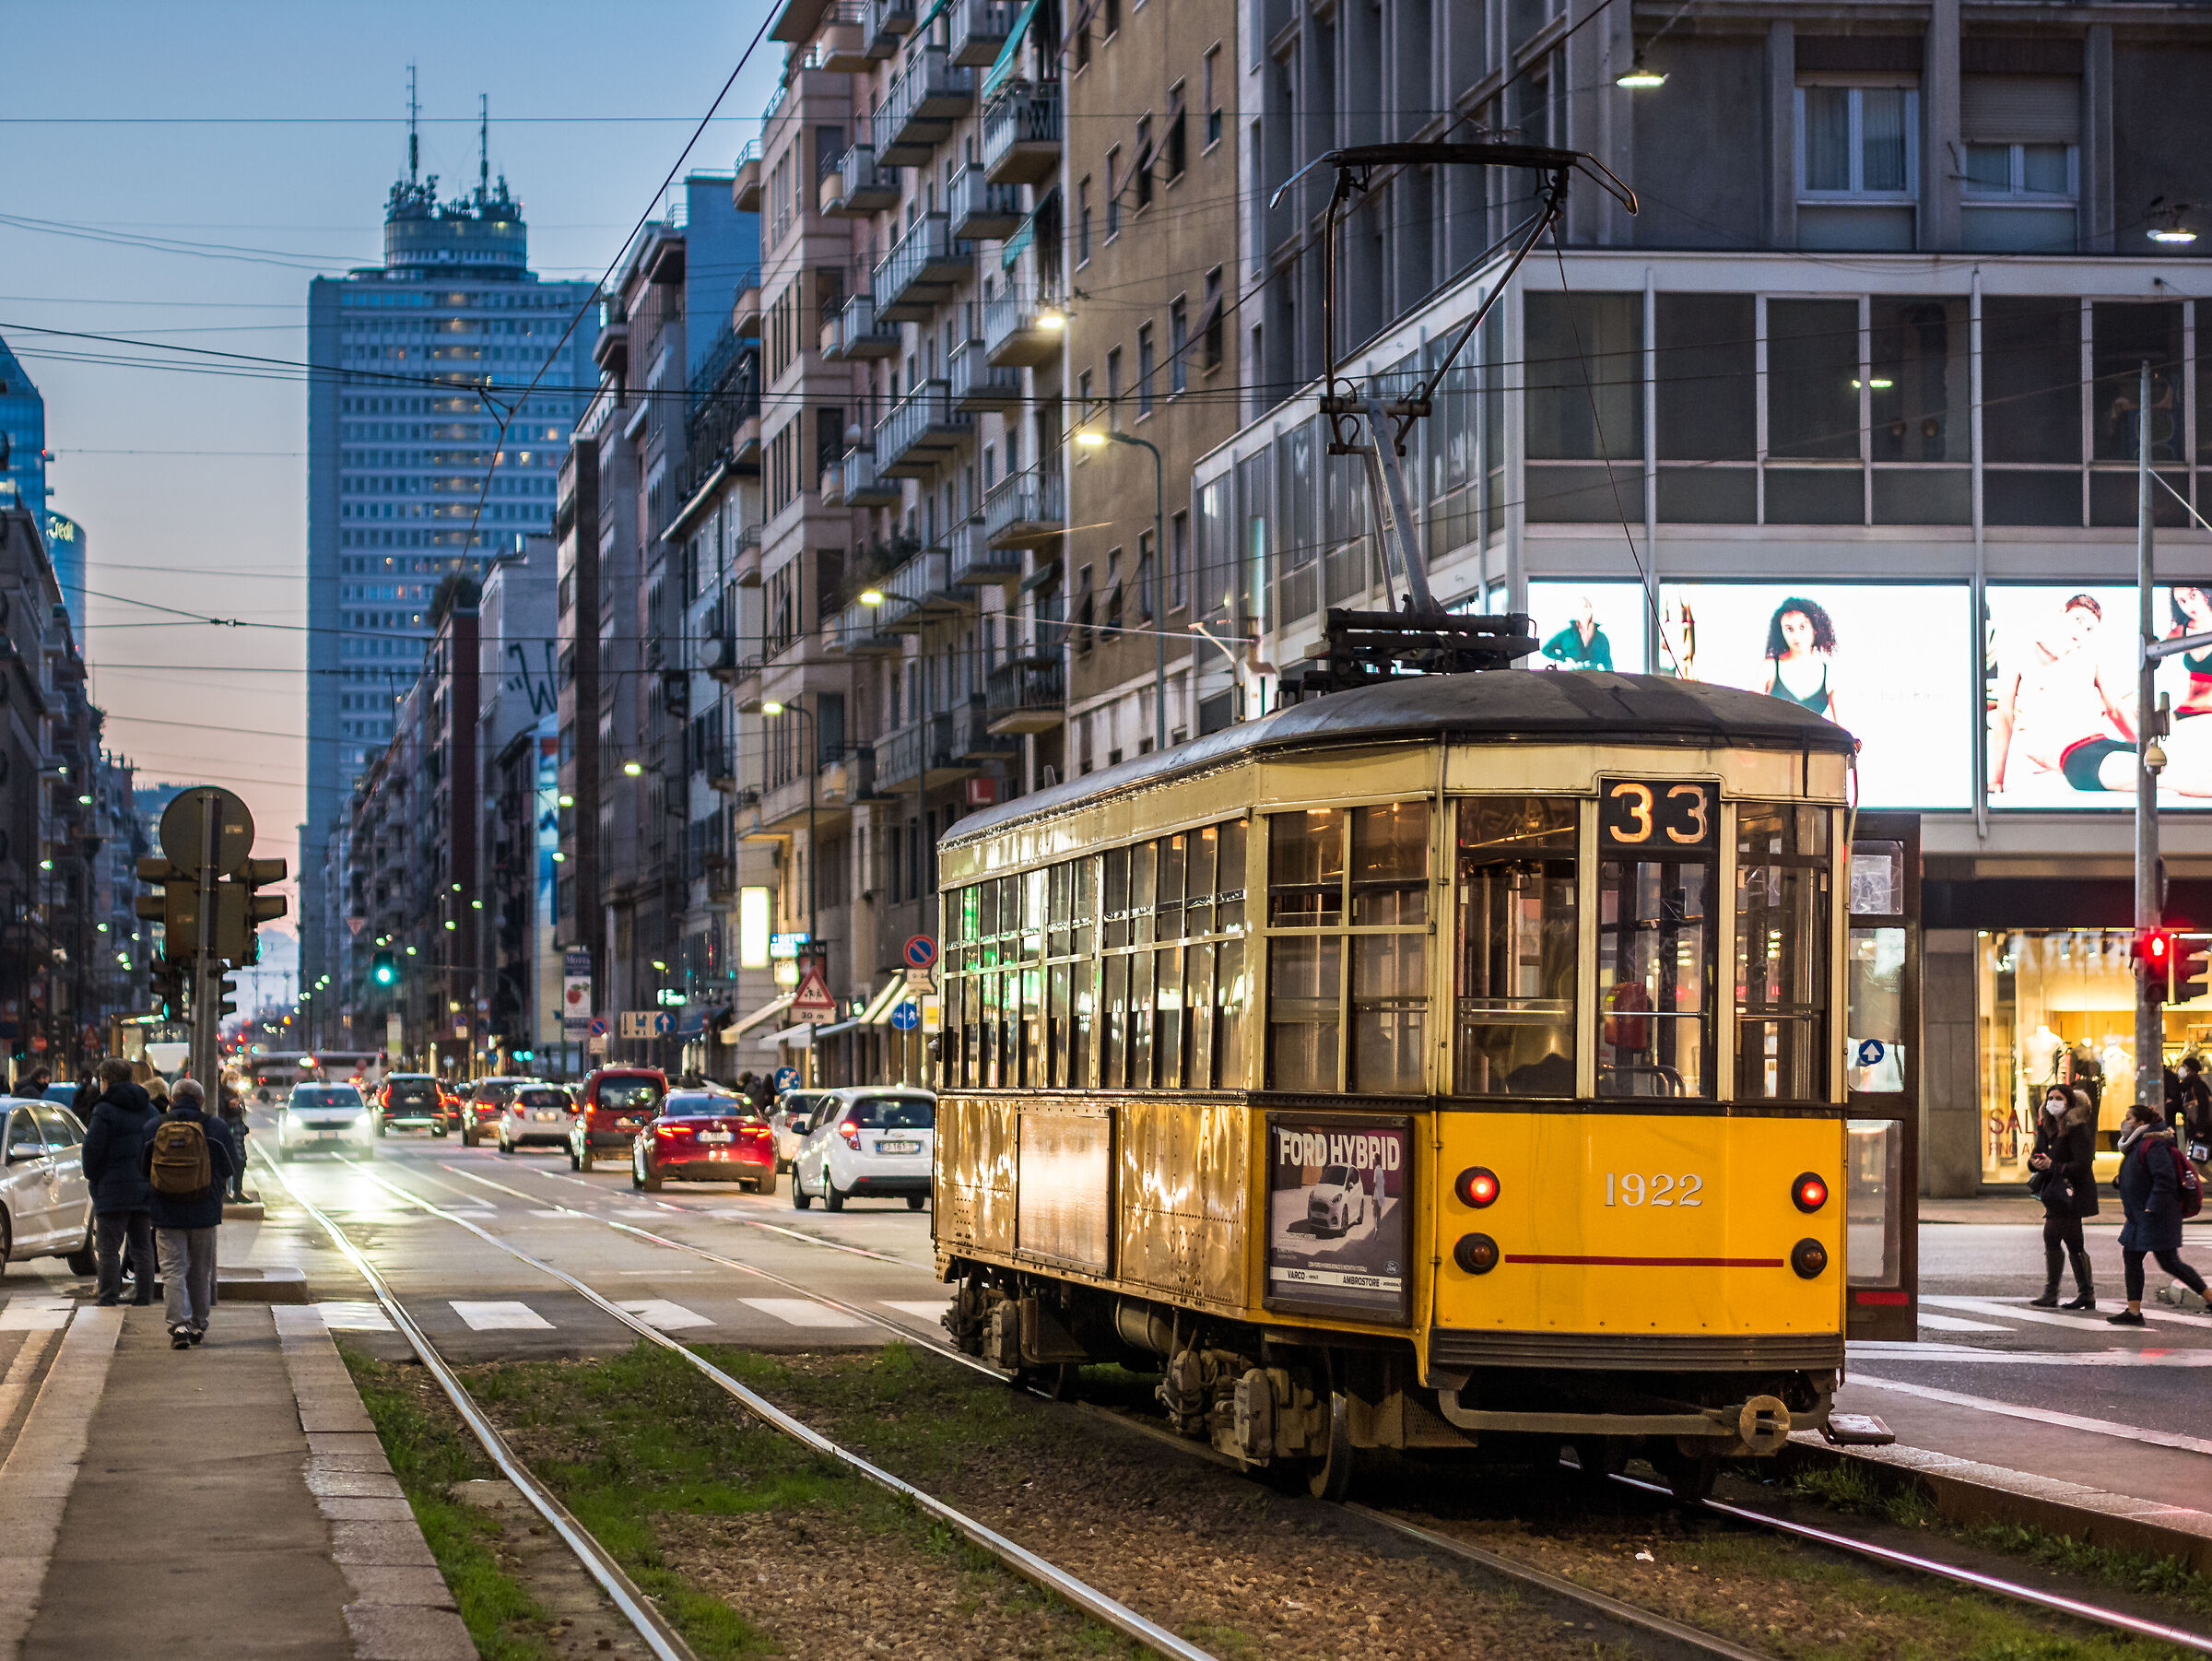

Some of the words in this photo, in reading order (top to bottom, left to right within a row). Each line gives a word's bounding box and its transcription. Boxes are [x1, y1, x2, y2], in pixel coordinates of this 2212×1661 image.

[1609, 783, 1708, 843] 33
[801, 1011, 813, 1019] 30
[1279, 1132, 1327, 1167] FORD
[1330, 1134, 1400, 1171] HYBRID
[1605, 1172, 1703, 1207] 1922
[1287, 1270, 1305, 1280] VARCO
[1342, 1276, 1380, 1287] AMBROSTORE
